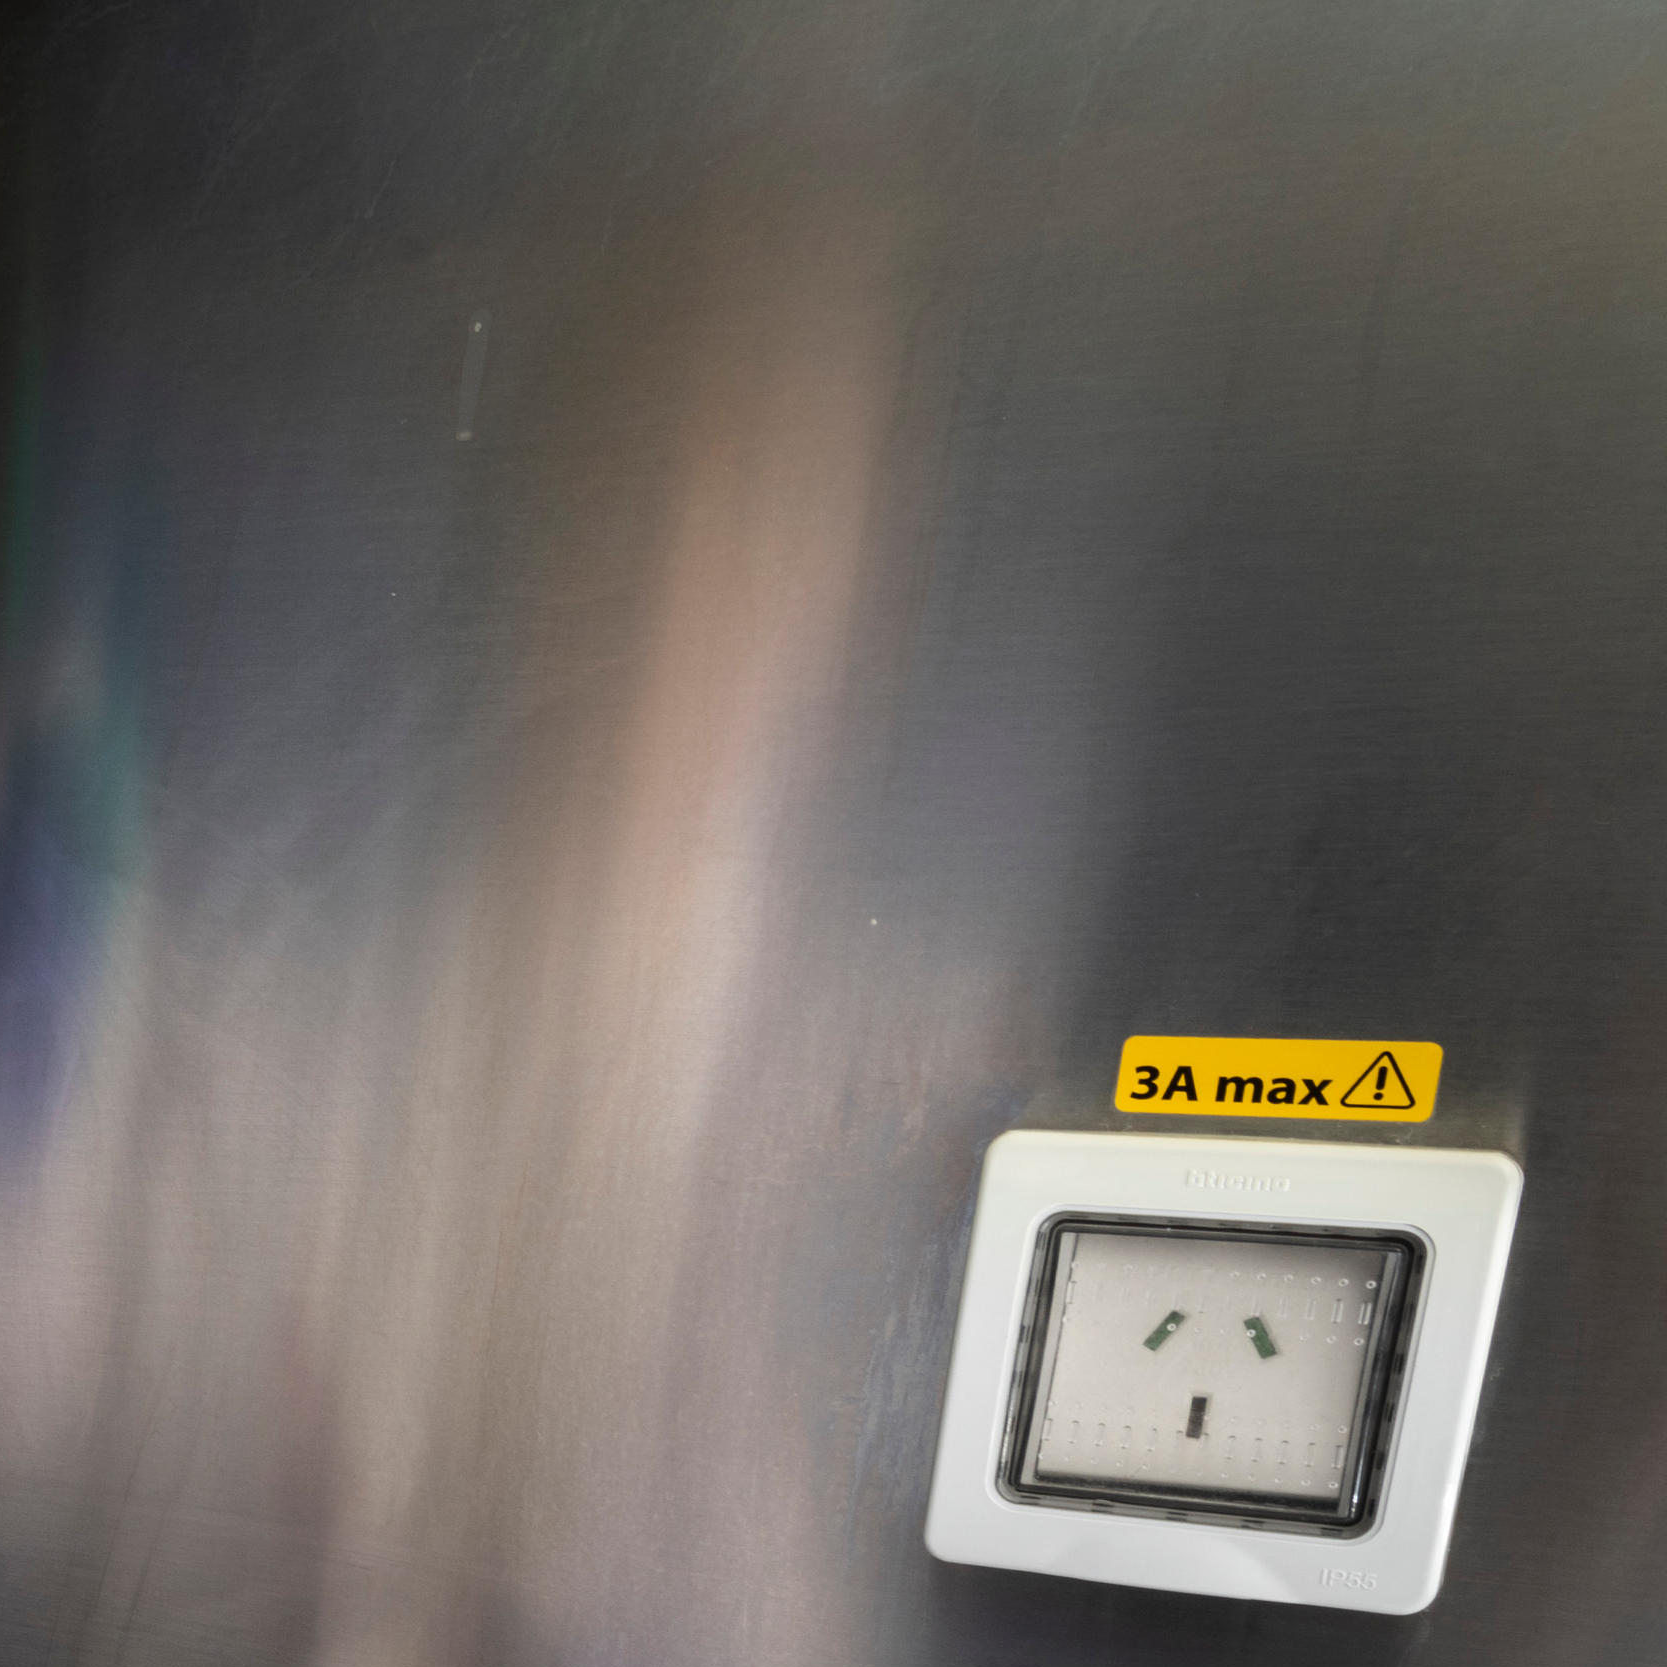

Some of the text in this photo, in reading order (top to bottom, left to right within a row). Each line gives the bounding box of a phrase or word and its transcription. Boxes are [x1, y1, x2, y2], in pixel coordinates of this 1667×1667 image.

[1130, 1065, 1333, 1105] 3A max
[1318, 1567, 1378, 1592] IP55
